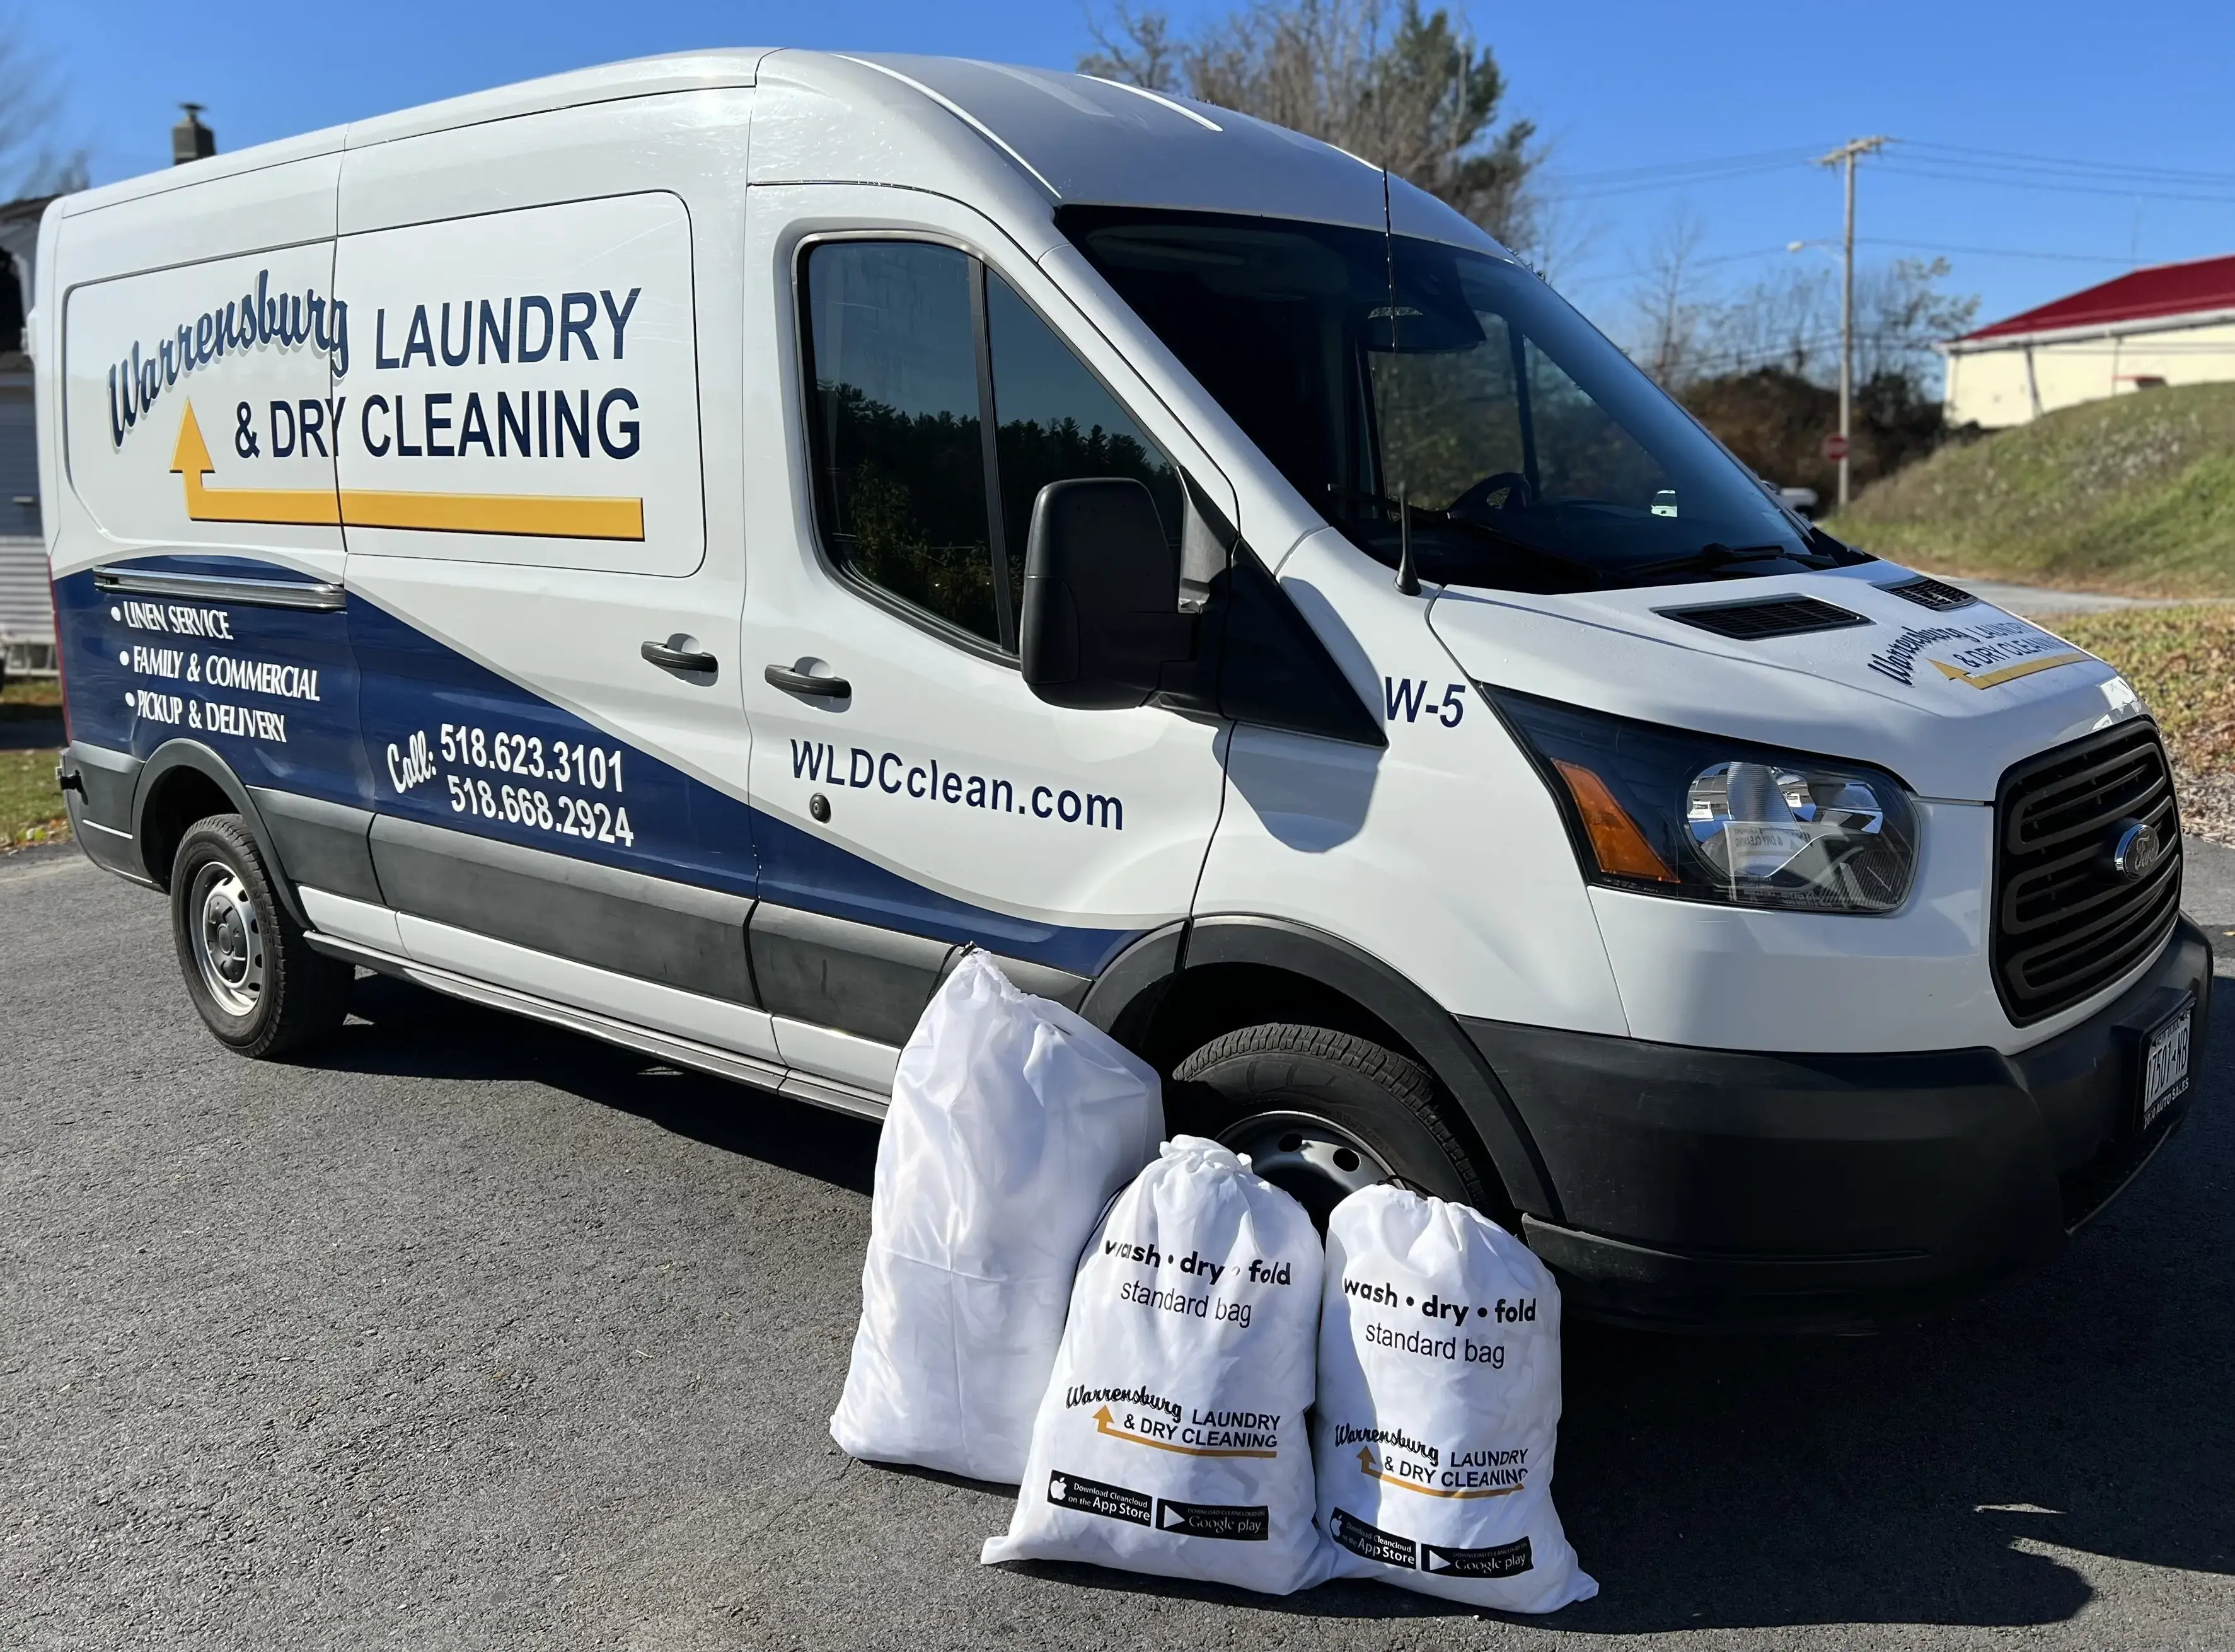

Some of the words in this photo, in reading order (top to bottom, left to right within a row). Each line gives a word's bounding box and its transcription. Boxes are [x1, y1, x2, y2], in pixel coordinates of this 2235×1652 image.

[108, 269, 349, 450] Warrensburg
[377, 287, 641, 370] LAUNDRY
[234, 401, 260, 458] &
[271, 396, 347, 458] DRY
[361, 388, 640, 459] CLEANING
[124, 601, 169, 632] LINEN
[168, 604, 234, 640] SERVICE
[134, 645, 183, 679] FAMILY
[187, 653, 200, 682] &
[206, 655, 320, 701] COMMERCIAL
[1953, 654, 1984, 667] &
[1964, 645, 2011, 664] DRY
[137, 690, 182, 724] PICKUP
[189, 700, 202, 729] &
[205, 702, 287, 742] DELIVERY
[1385, 676, 1466, 728] W-5
[387, 730, 437, 794] Call:
[441, 723, 623, 793] 518.623.3101
[790, 739, 1123, 831] WLDCclean.com
[447, 775, 635, 847] 518.668.2924
[2172, 1077, 2189, 1101] SALES
[1104, 1239, 1161, 1268] wash
[1180, 1251, 1225, 1285] dry
[1249, 1259, 1291, 1286] fold
[1119, 1280, 1210, 1319] standard
[1215, 1297, 1252, 1328] bag
[1344, 1278, 1398, 1308] wash
[1421, 1295, 1469, 1327] dry
[1494, 1298, 1537, 1324] fold
[1365, 1322, 1456, 1360] standard
[1465, 1338, 1504, 1370] bag
[1065, 1384, 1182, 1423] Warrensburg
[1192, 1409, 1281, 1430] LAUNDRY
[1123, 1414, 1135, 1430] &
[1140, 1417, 1178, 1440] DRY
[1182, 1428, 1278, 1448] CLEANING
[1335, 1423, 1439, 1467] Warrensburg
[1450, 1448, 1529, 1467] LAUNDRY
[1384, 1455, 1394, 1472] &
[1399, 1460, 1436, 1484] DRY
[1073, 1482, 1109, 1498] Download
[1109, 1492, 1148, 1508] Cleancloud
[1080, 1498, 1092, 1506] the
[1092, 1496, 1118, 1515] App
[1119, 1503, 1150, 1521] Store
[1189, 1515, 1235, 1534] Google
[1238, 1519, 1261, 1534] play
[1374, 1535, 1412, 1553] Cleancloud
[1358, 1537, 1381, 1557] App
[1382, 1546, 1415, 1564] Store
[1455, 1557, 1502, 1574] Google
[1505, 1553, 1526, 1570] play
